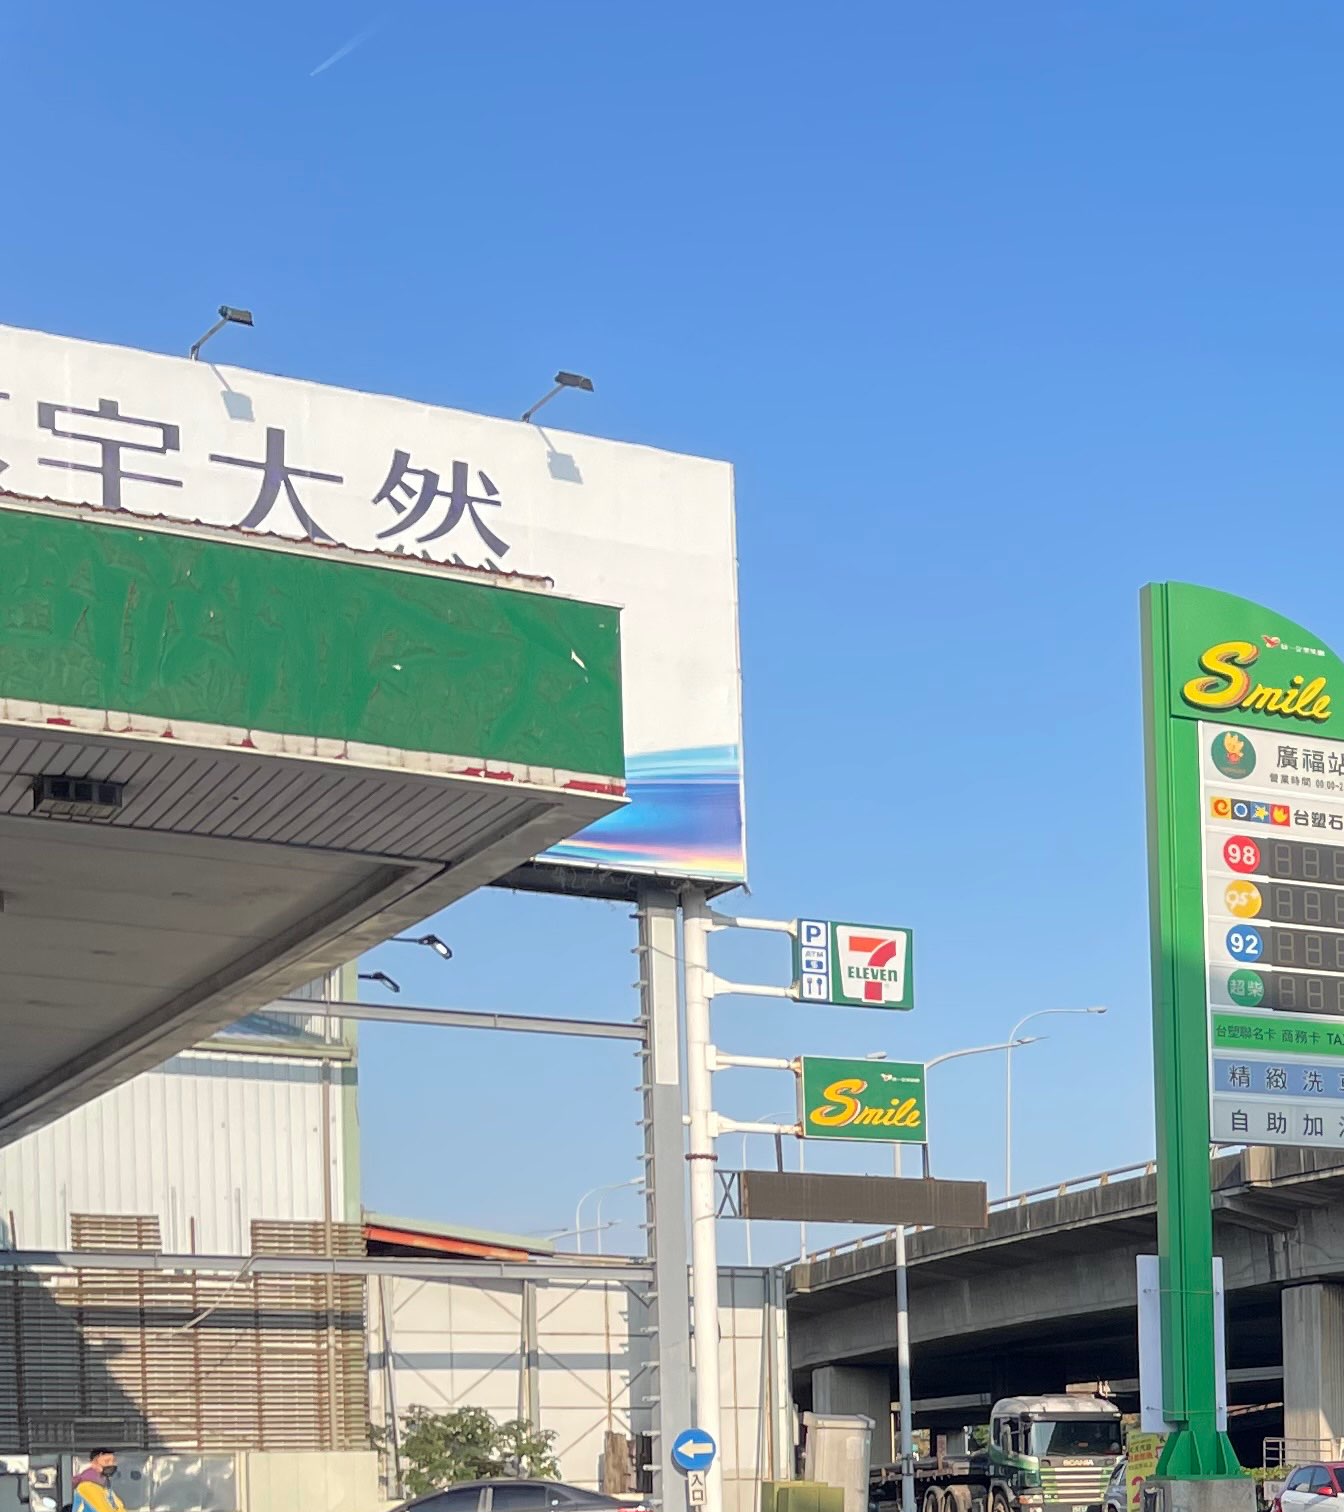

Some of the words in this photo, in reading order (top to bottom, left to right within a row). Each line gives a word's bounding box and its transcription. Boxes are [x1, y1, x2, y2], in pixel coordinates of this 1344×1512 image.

[1181, 640, 1333, 722] Smile
[1227, 843, 1256, 865] 98
[806, 924, 822, 943] P
[1230, 932, 1259, 955] 92
[804, 950, 824, 958] ATM
[848, 935, 897, 1001] 7
[809, 1078, 922, 1128] Smile
[691, 1473, 704, 1502] 入口
